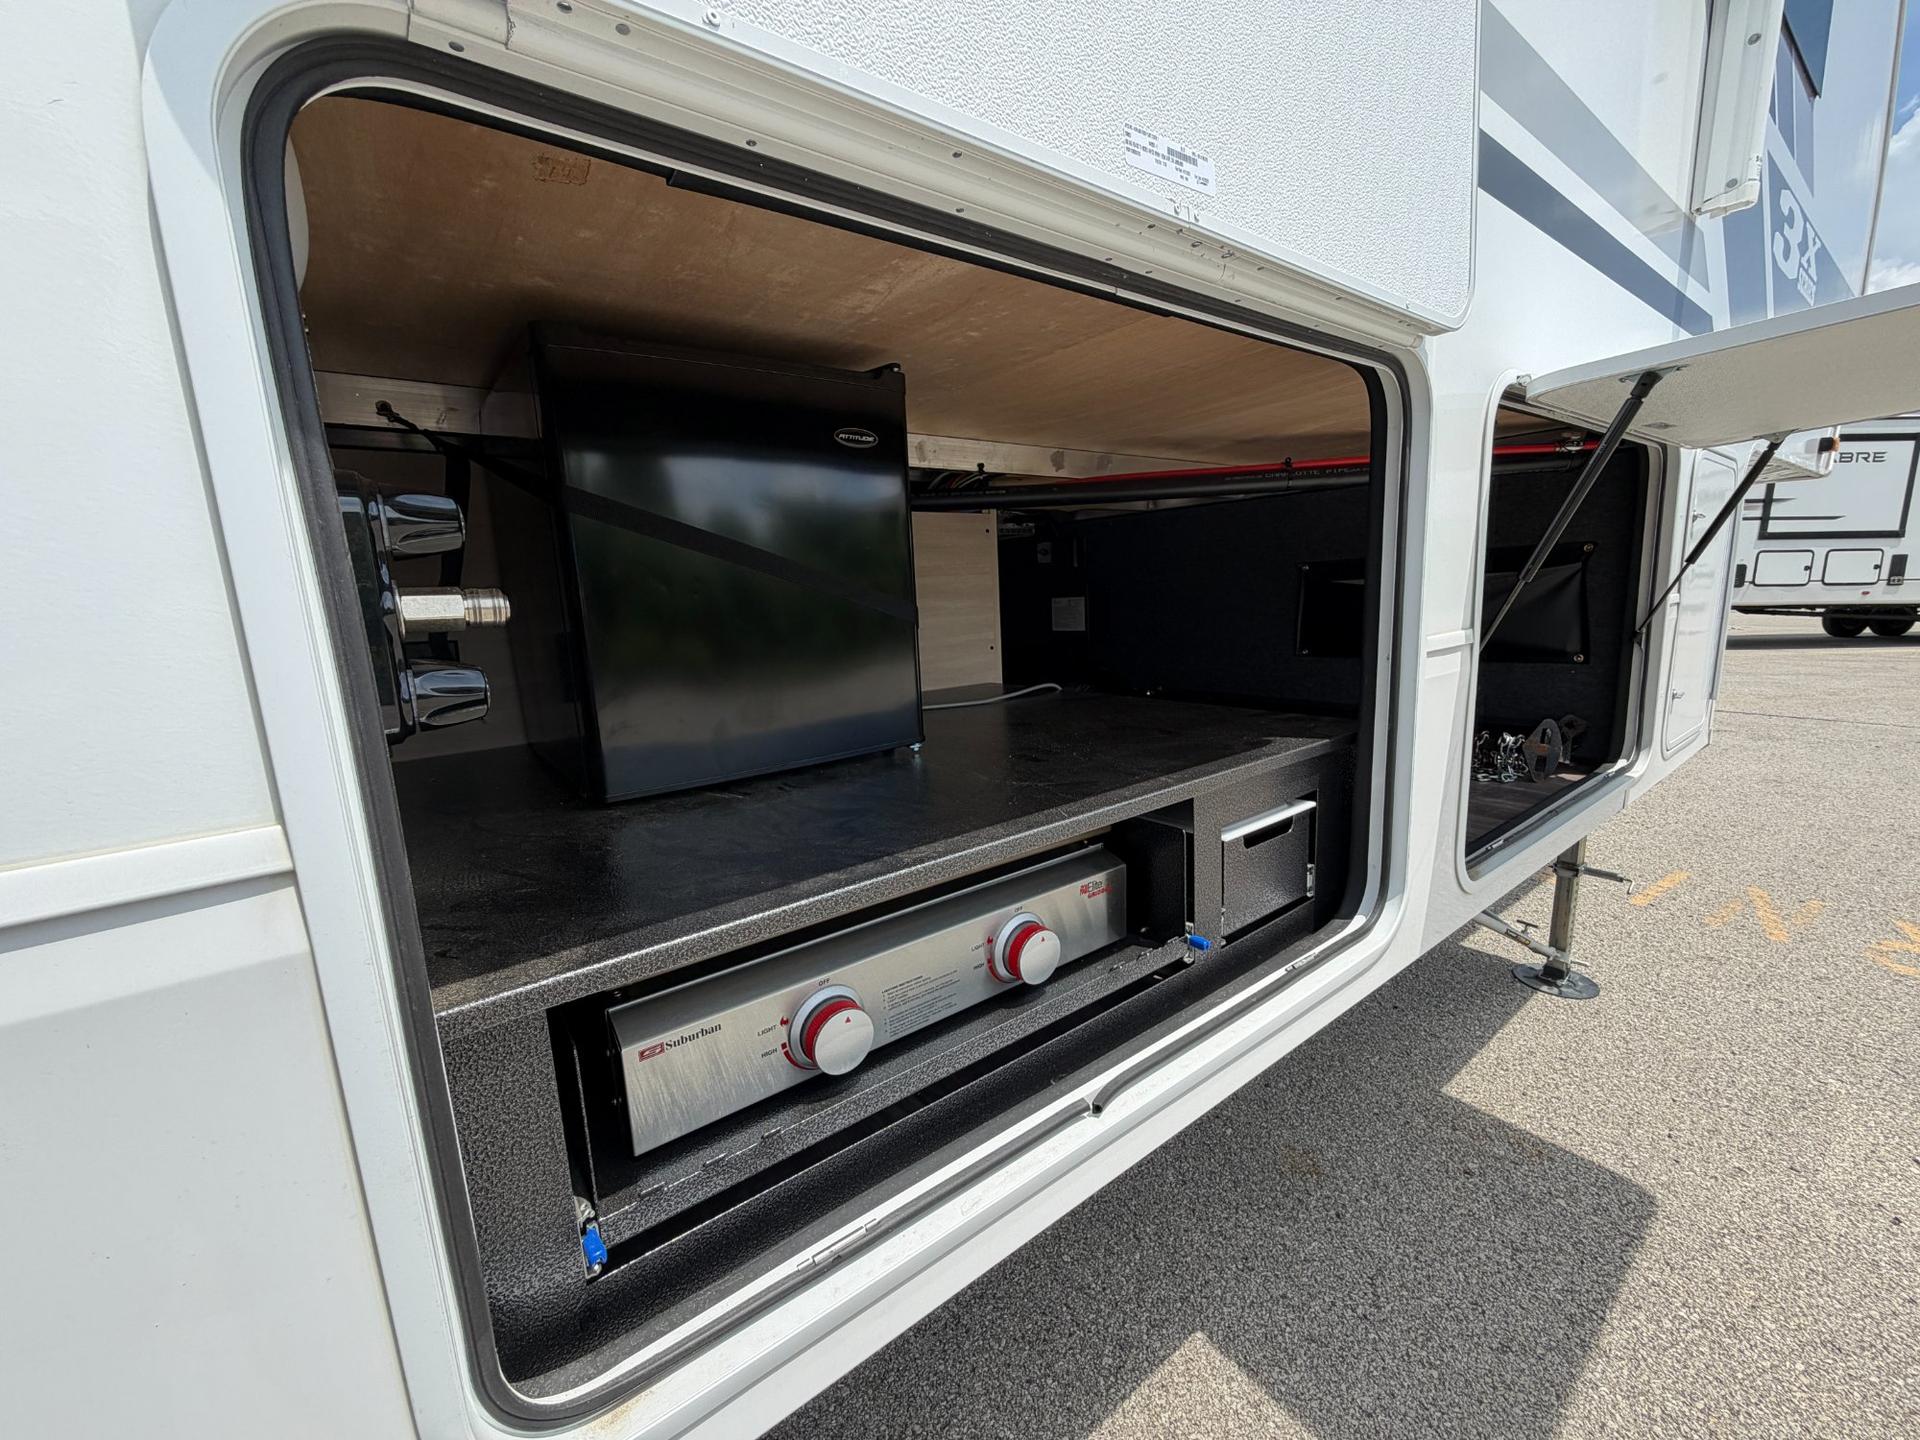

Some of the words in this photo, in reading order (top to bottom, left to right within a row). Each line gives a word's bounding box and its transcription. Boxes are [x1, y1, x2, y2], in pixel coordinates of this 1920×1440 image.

[818, 978, 831, 987] OFF
[757, 1024, 777, 1037] LIGHT
[665, 1023, 722, 1051] Suburban
[761, 1047, 778, 1058] HIGH
